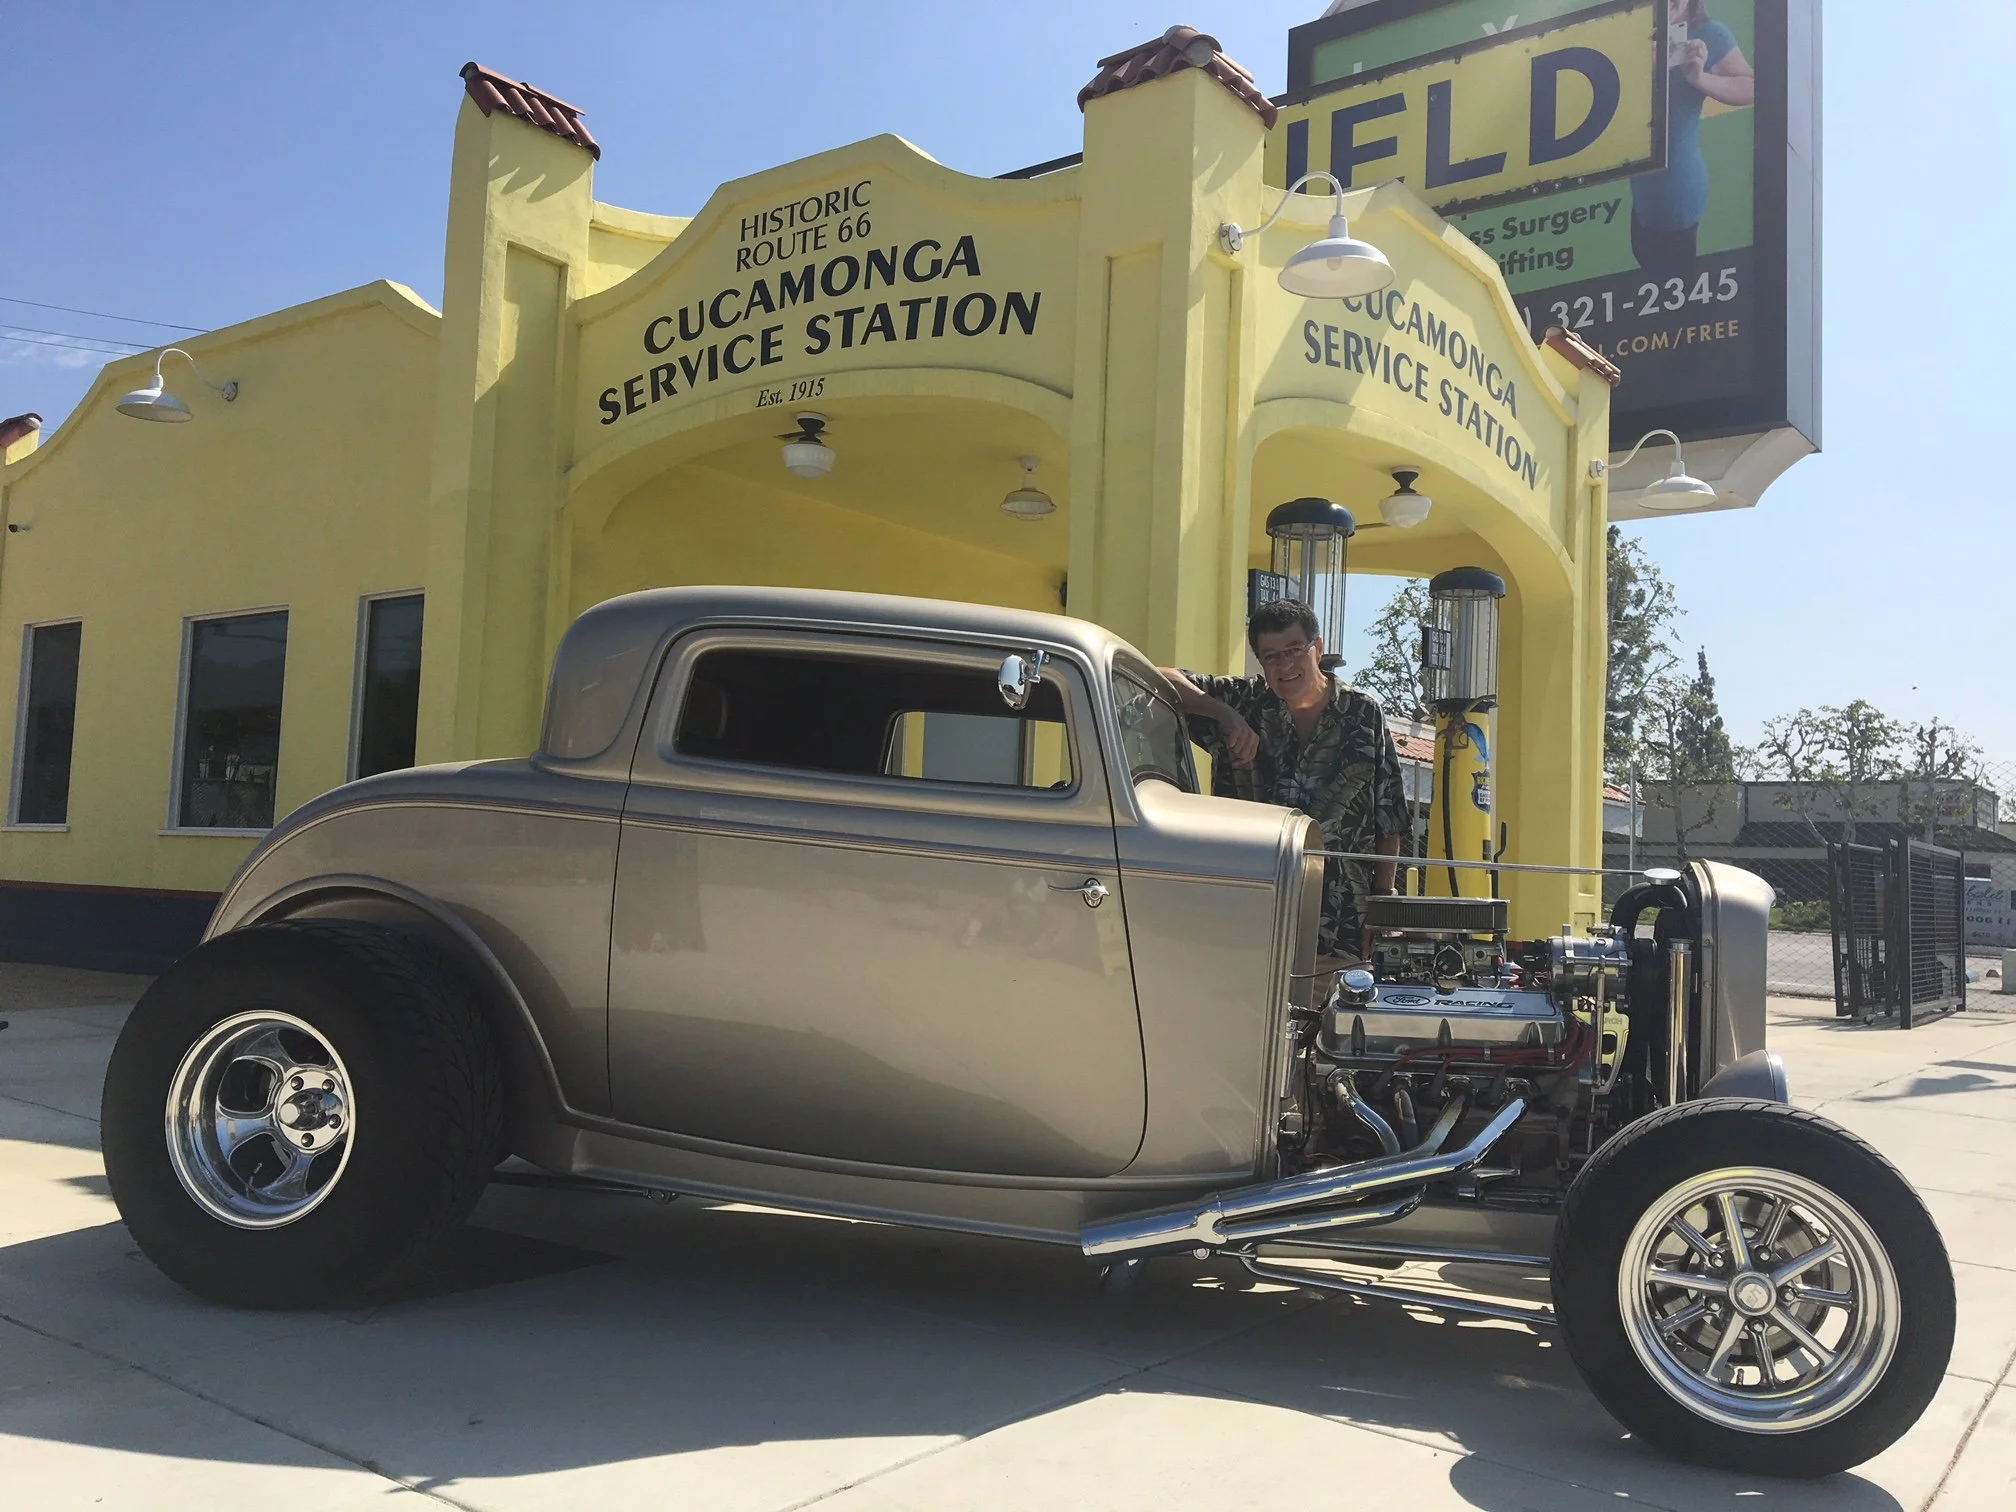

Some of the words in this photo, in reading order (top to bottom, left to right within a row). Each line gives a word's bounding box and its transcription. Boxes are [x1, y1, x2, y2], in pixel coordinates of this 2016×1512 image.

[735, 223, 828, 273] ROUTE
[838, 210, 872, 244] 66
[740, 180, 872, 242] HISTORIC
[1502, 198, 1622, 240] Surgery
[643, 234, 981, 355] CUCAMONGA
[1550, 267, 1739, 330] 321-2345
[598, 324, 785, 425] SERVICE
[803, 291, 1042, 355] STATION
[755, 388, 784, 409] Est.
[788, 377, 826, 402] 1915
[1303, 319, 1429, 403] SERVICE
[1438, 378, 1538, 491] STATION
[1392, 995, 1421, 1006] Ford
[1433, 999, 1516, 1009] RACING
